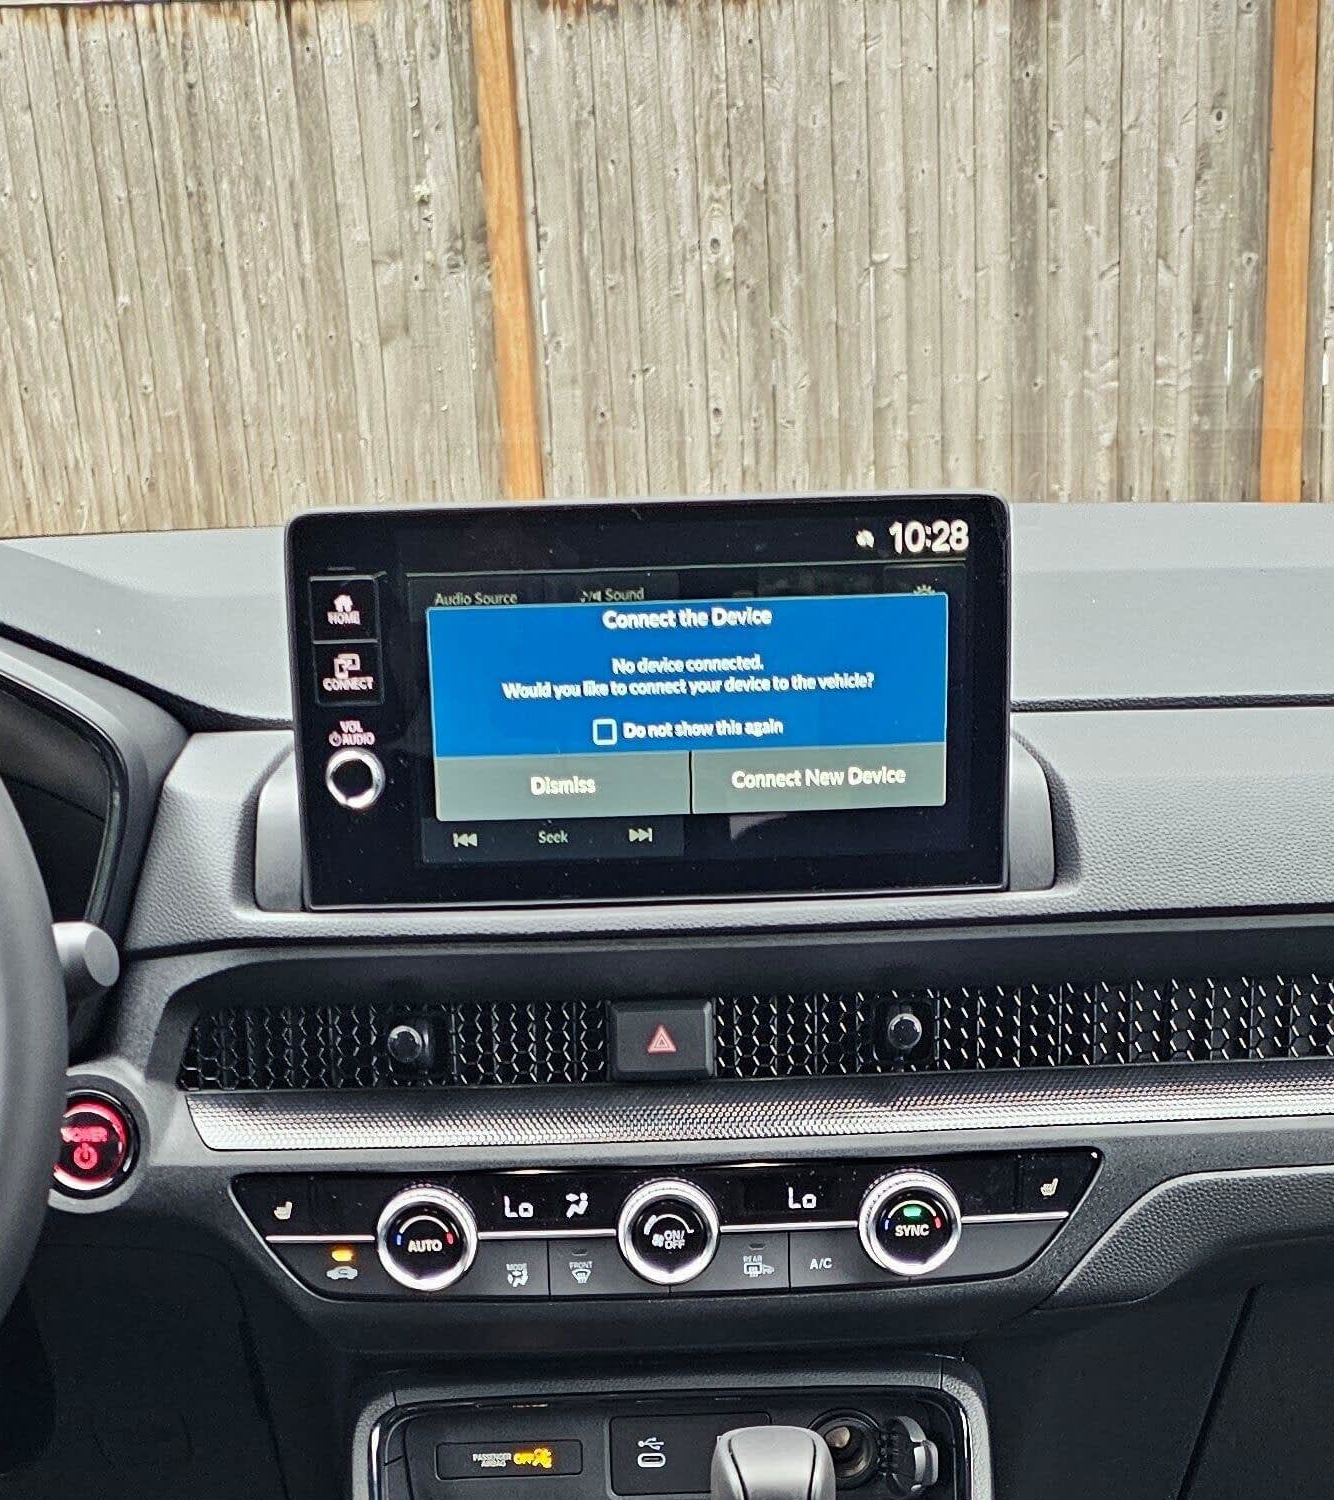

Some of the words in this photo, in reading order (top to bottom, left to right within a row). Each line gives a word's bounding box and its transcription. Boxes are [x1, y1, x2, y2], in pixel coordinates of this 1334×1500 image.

[889, 520, 969, 554] 10:28
[435, 592, 471, 606] Audio
[475, 591, 517, 605] Source
[605, 587, 644, 602] Sound
[327, 610, 361, 625] HOME
[602, 609, 676, 629] Connect
[679, 609, 708, 627] the
[711, 607, 772, 626] Device
[612, 658, 635, 675] No
[637, 656, 684, 674] device
[685, 654, 764, 672] connected.
[322, 676, 373, 691] CONNECT
[501, 682, 551, 699] Would
[553, 685, 581, 702] you
[582, 680, 608, 697] like
[610, 681, 627, 695] to
[628, 678, 687, 695] connect
[689, 681, 722, 697] your
[724, 676, 769, 693] device
[772, 675, 788, 690] to
[790, 674, 816, 690] the
[817, 672, 874, 690] vehicle?
[339, 720, 363, 733] VOL
[623, 722, 645, 739] Do
[647, 722, 673, 738] not
[674, 720, 714, 738] show
[716, 719, 742, 736] this
[744, 718, 783, 738] again
[342, 732, 375, 746] AUDIO
[731, 769, 802, 789] Connect
[805, 768, 844, 787] New
[847, 766, 906, 785] Device
[530, 776, 596, 795] Dismiss
[538, 830, 568, 844] Seek
[788, 1187, 816, 1208] Lo
[504, 1195, 533, 1217] Lo
[664, 1230, 684, 1240] ON/
[895, 1224, 929, 1237] SYNC
[408, 1239, 442, 1252] AUTO
[664, 1239, 685, 1250] OFF
[506, 1263, 527, 1271] MODE
[569, 1261, 593, 1269] FRONT
[810, 1258, 832, 1270] A/C
